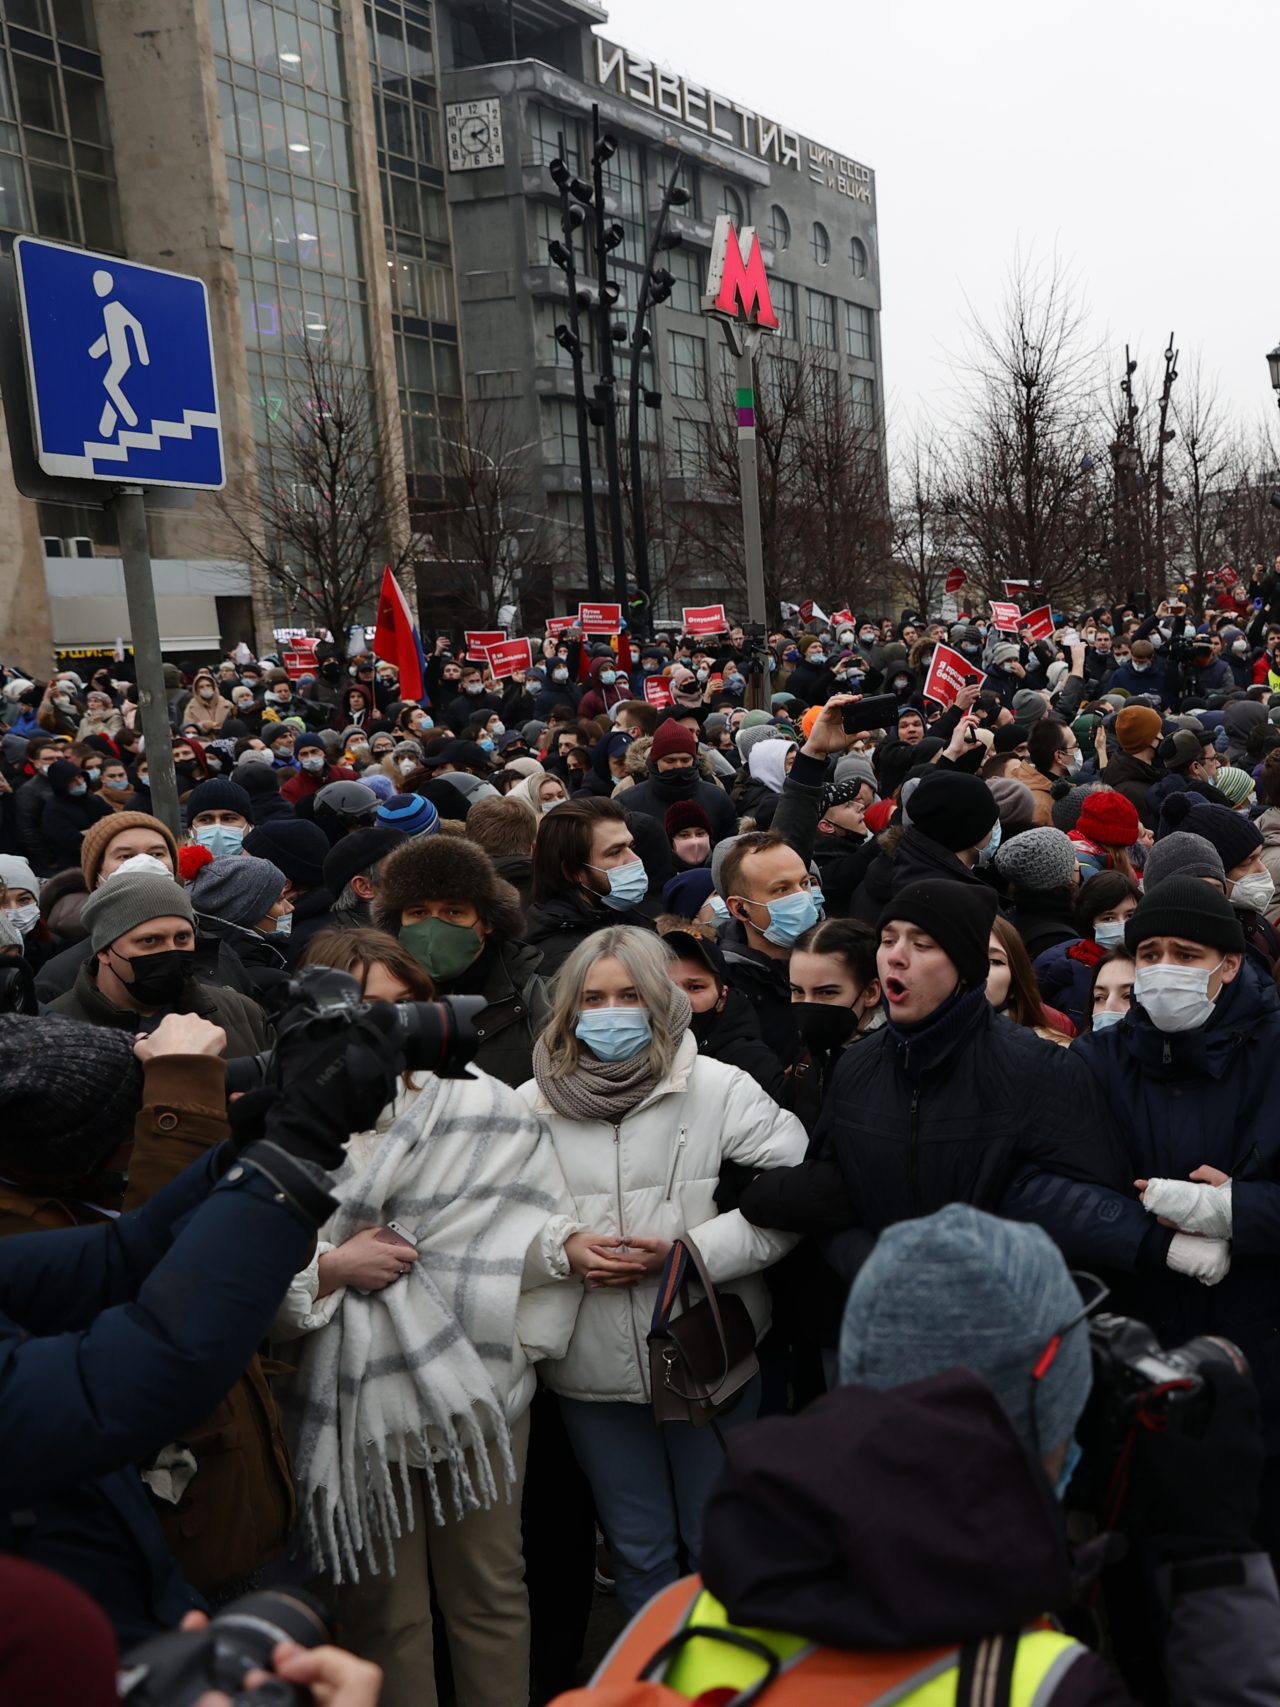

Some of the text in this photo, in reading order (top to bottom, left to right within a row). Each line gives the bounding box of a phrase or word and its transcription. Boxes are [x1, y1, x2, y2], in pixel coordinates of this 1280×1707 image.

[468, 104, 477, 114] 12
[486, 102, 490, 113] 1
[594, 37, 801, 171] ИЗВЕСТИЯ
[455, 106, 462, 116] 11
[492, 109, 498, 120] 2
[448, 116, 456, 127] 10
[493, 127, 499, 138] 3
[451, 133, 457, 144] 9
[452, 150, 459, 160] 8
[474, 154, 480, 165] 6
[488, 153, 494, 163] 5
[808, 143, 870, 182] ЦИК СССР
[836, 175, 871, 204] ВЦИК
[714, 219, 780, 330] М
[687, 614, 721, 624] Отпускай!
[938, 660, 947, 670] Я
